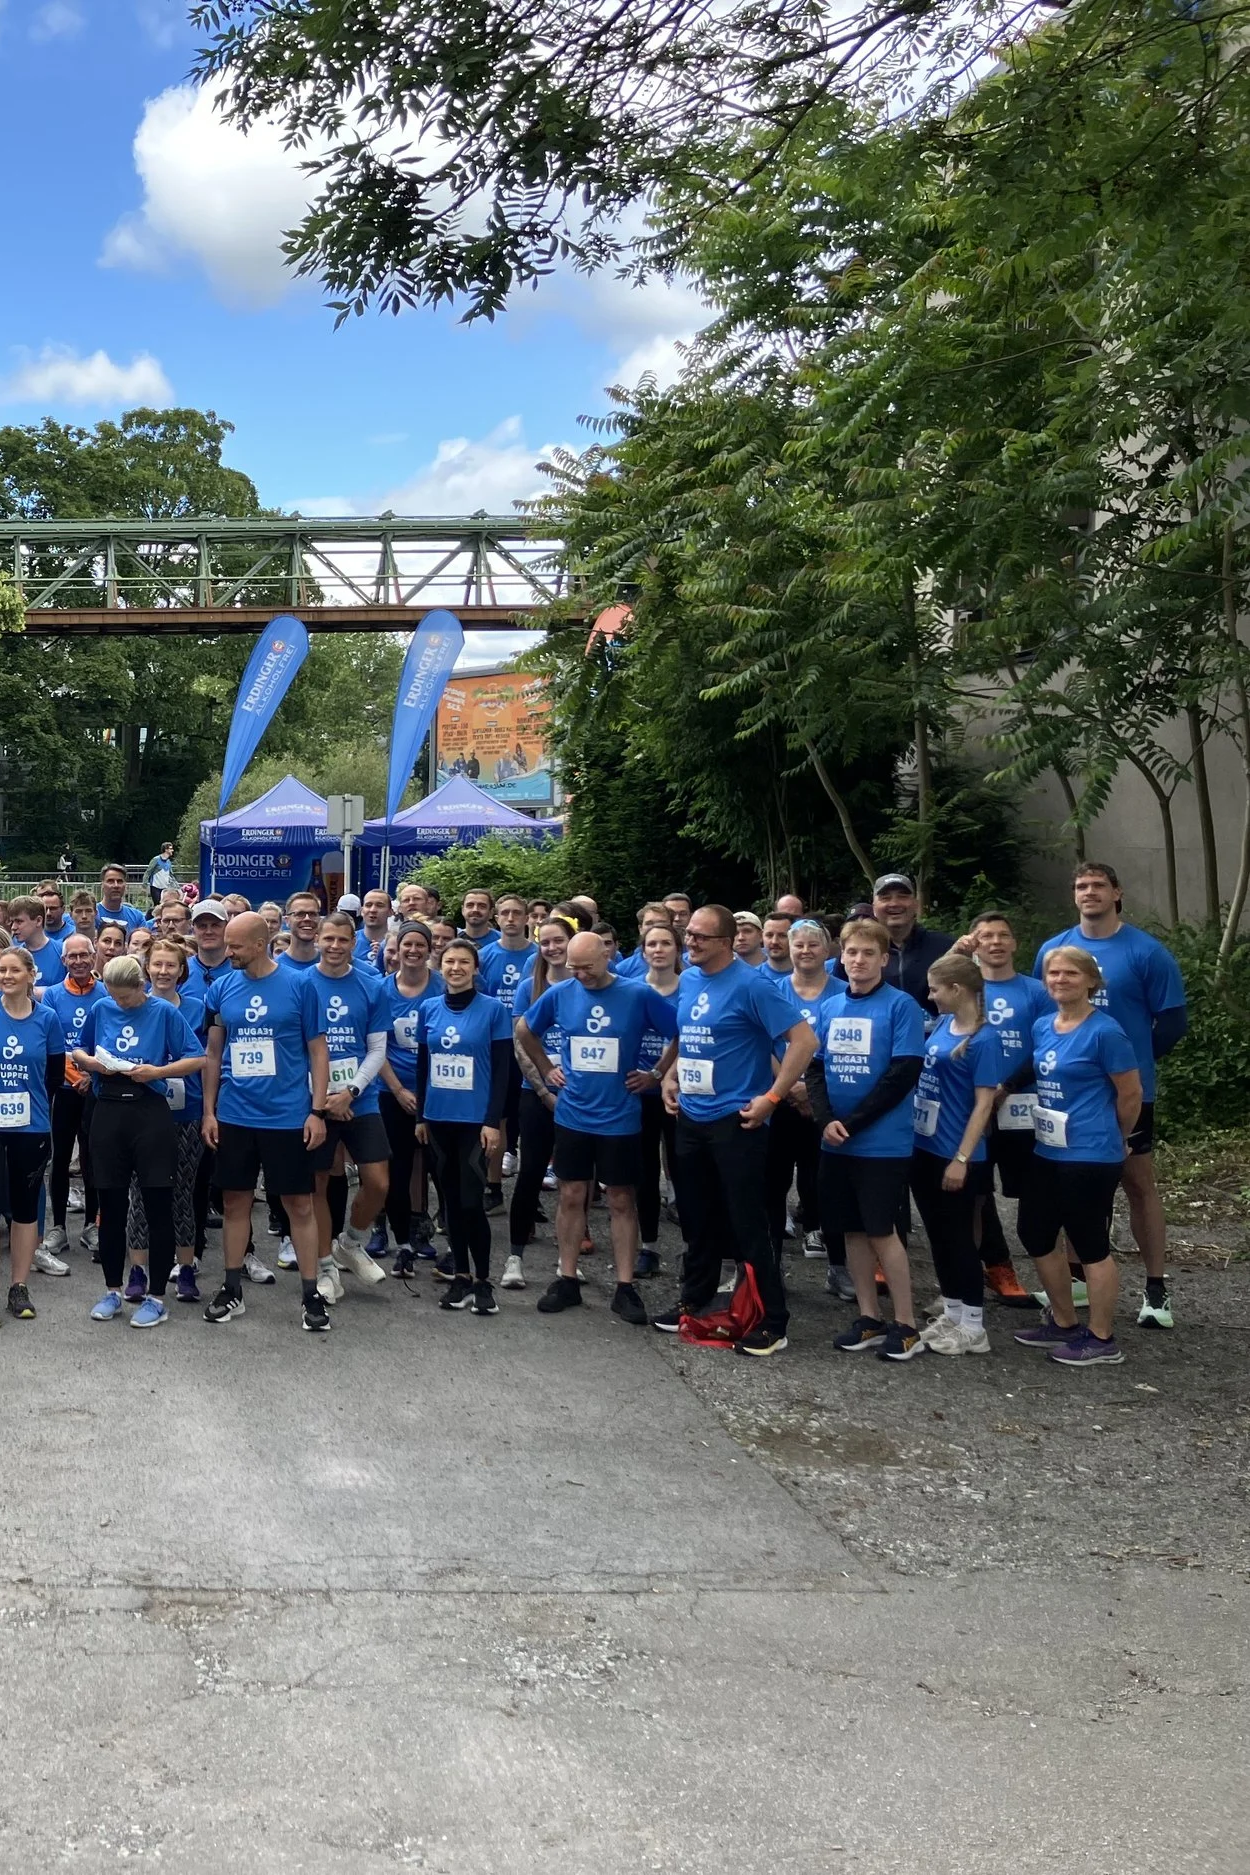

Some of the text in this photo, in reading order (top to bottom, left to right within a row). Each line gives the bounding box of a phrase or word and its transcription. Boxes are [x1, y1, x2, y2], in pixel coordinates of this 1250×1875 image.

[403, 647, 439, 708] ERDINGER
[418, 636, 450, 710] ALKOHOLFREI
[241, 652, 281, 712] ERDINGER
[256, 644, 296, 717] ALKOHOLFREI
[241, 828, 275, 837] ERDINGER
[416, 827, 451, 835] ERDINGER
[210, 852, 276, 868] ERDINGER
[237, 1027, 274, 1036] BUGA31
[682, 1025, 711, 1035] BUGA31
[833, 1028, 863, 1042] 2948
[325, 1035, 356, 1043] UPPER
[327, 1044, 346, 1052] TAL
[580, 1047, 606, 1060] 847
[686, 1045, 701, 1054] TAL
[239, 1051, 263, 1065] 739
[832, 1055, 868, 1064] BUGA31
[332, 1067, 354, 1082] 610
[435, 1064, 466, 1078] 1510
[830, 1065, 870, 1074] WUPPER
[682, 1068, 702, 1083] 759
[839, 1074, 856, 1083] TAL
[2, 1079, 18, 1087] TAL
